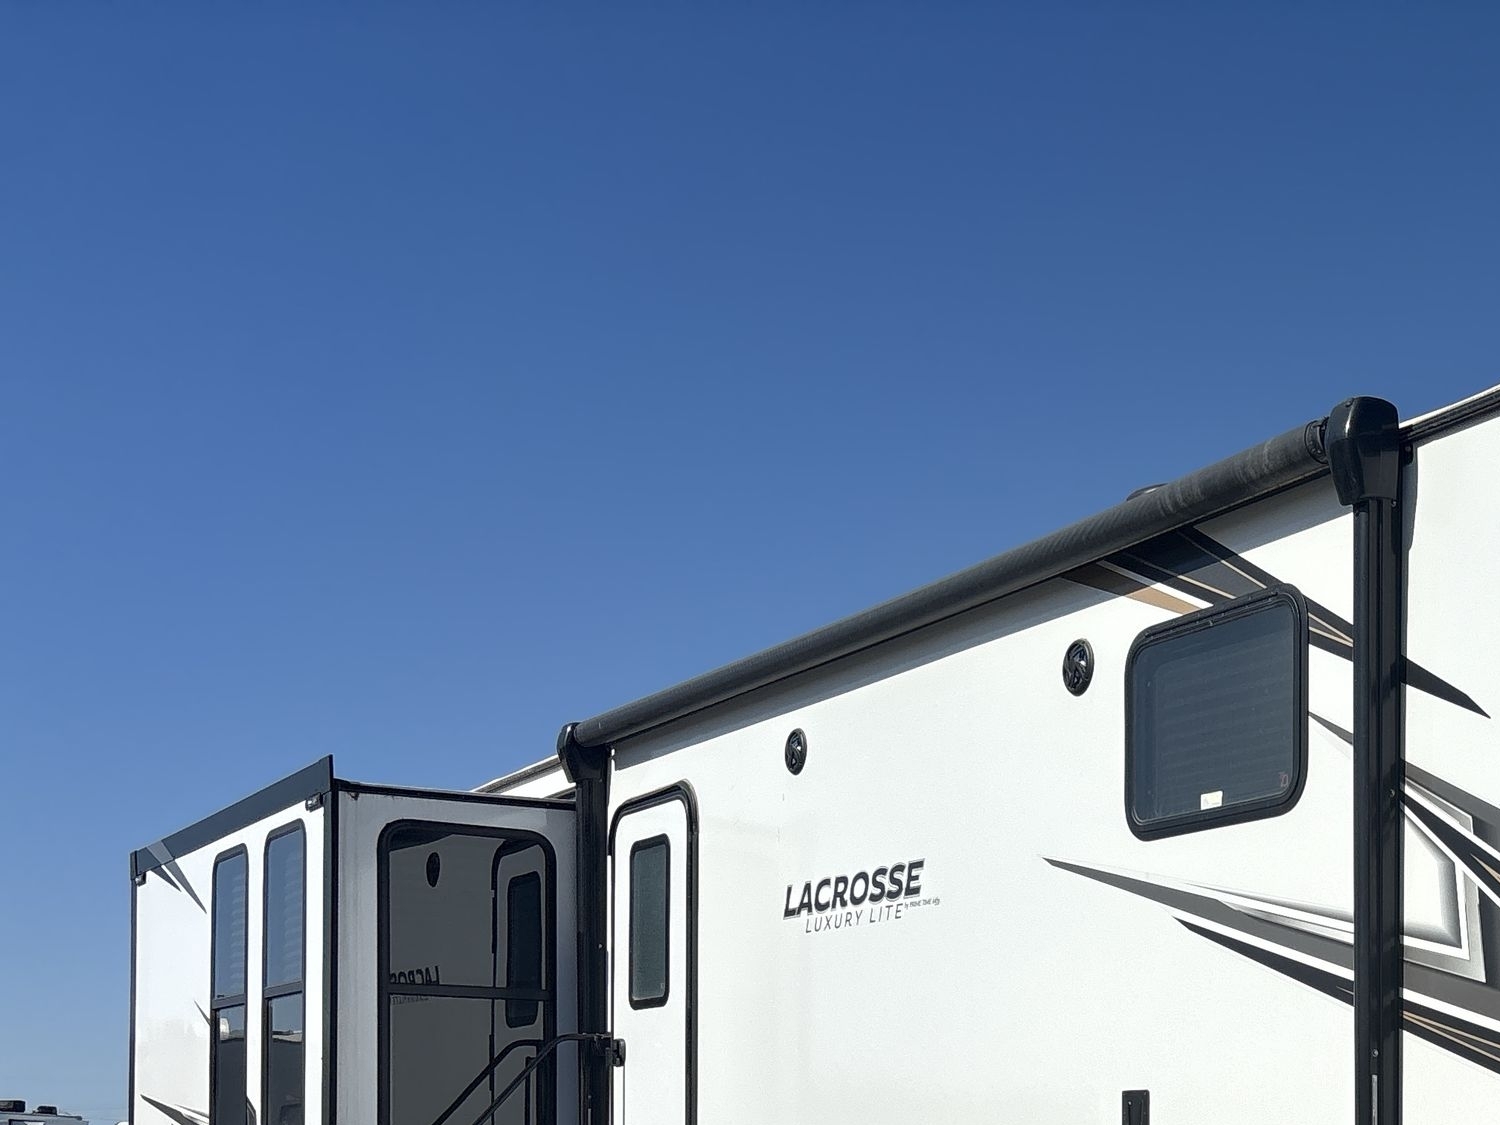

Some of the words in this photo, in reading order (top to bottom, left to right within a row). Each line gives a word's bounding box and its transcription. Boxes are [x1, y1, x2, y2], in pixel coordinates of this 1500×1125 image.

[783, 858, 925, 920] LACROSSE
[805, 909, 864, 933] LUXURY
[869, 903, 904, 923] LITE
